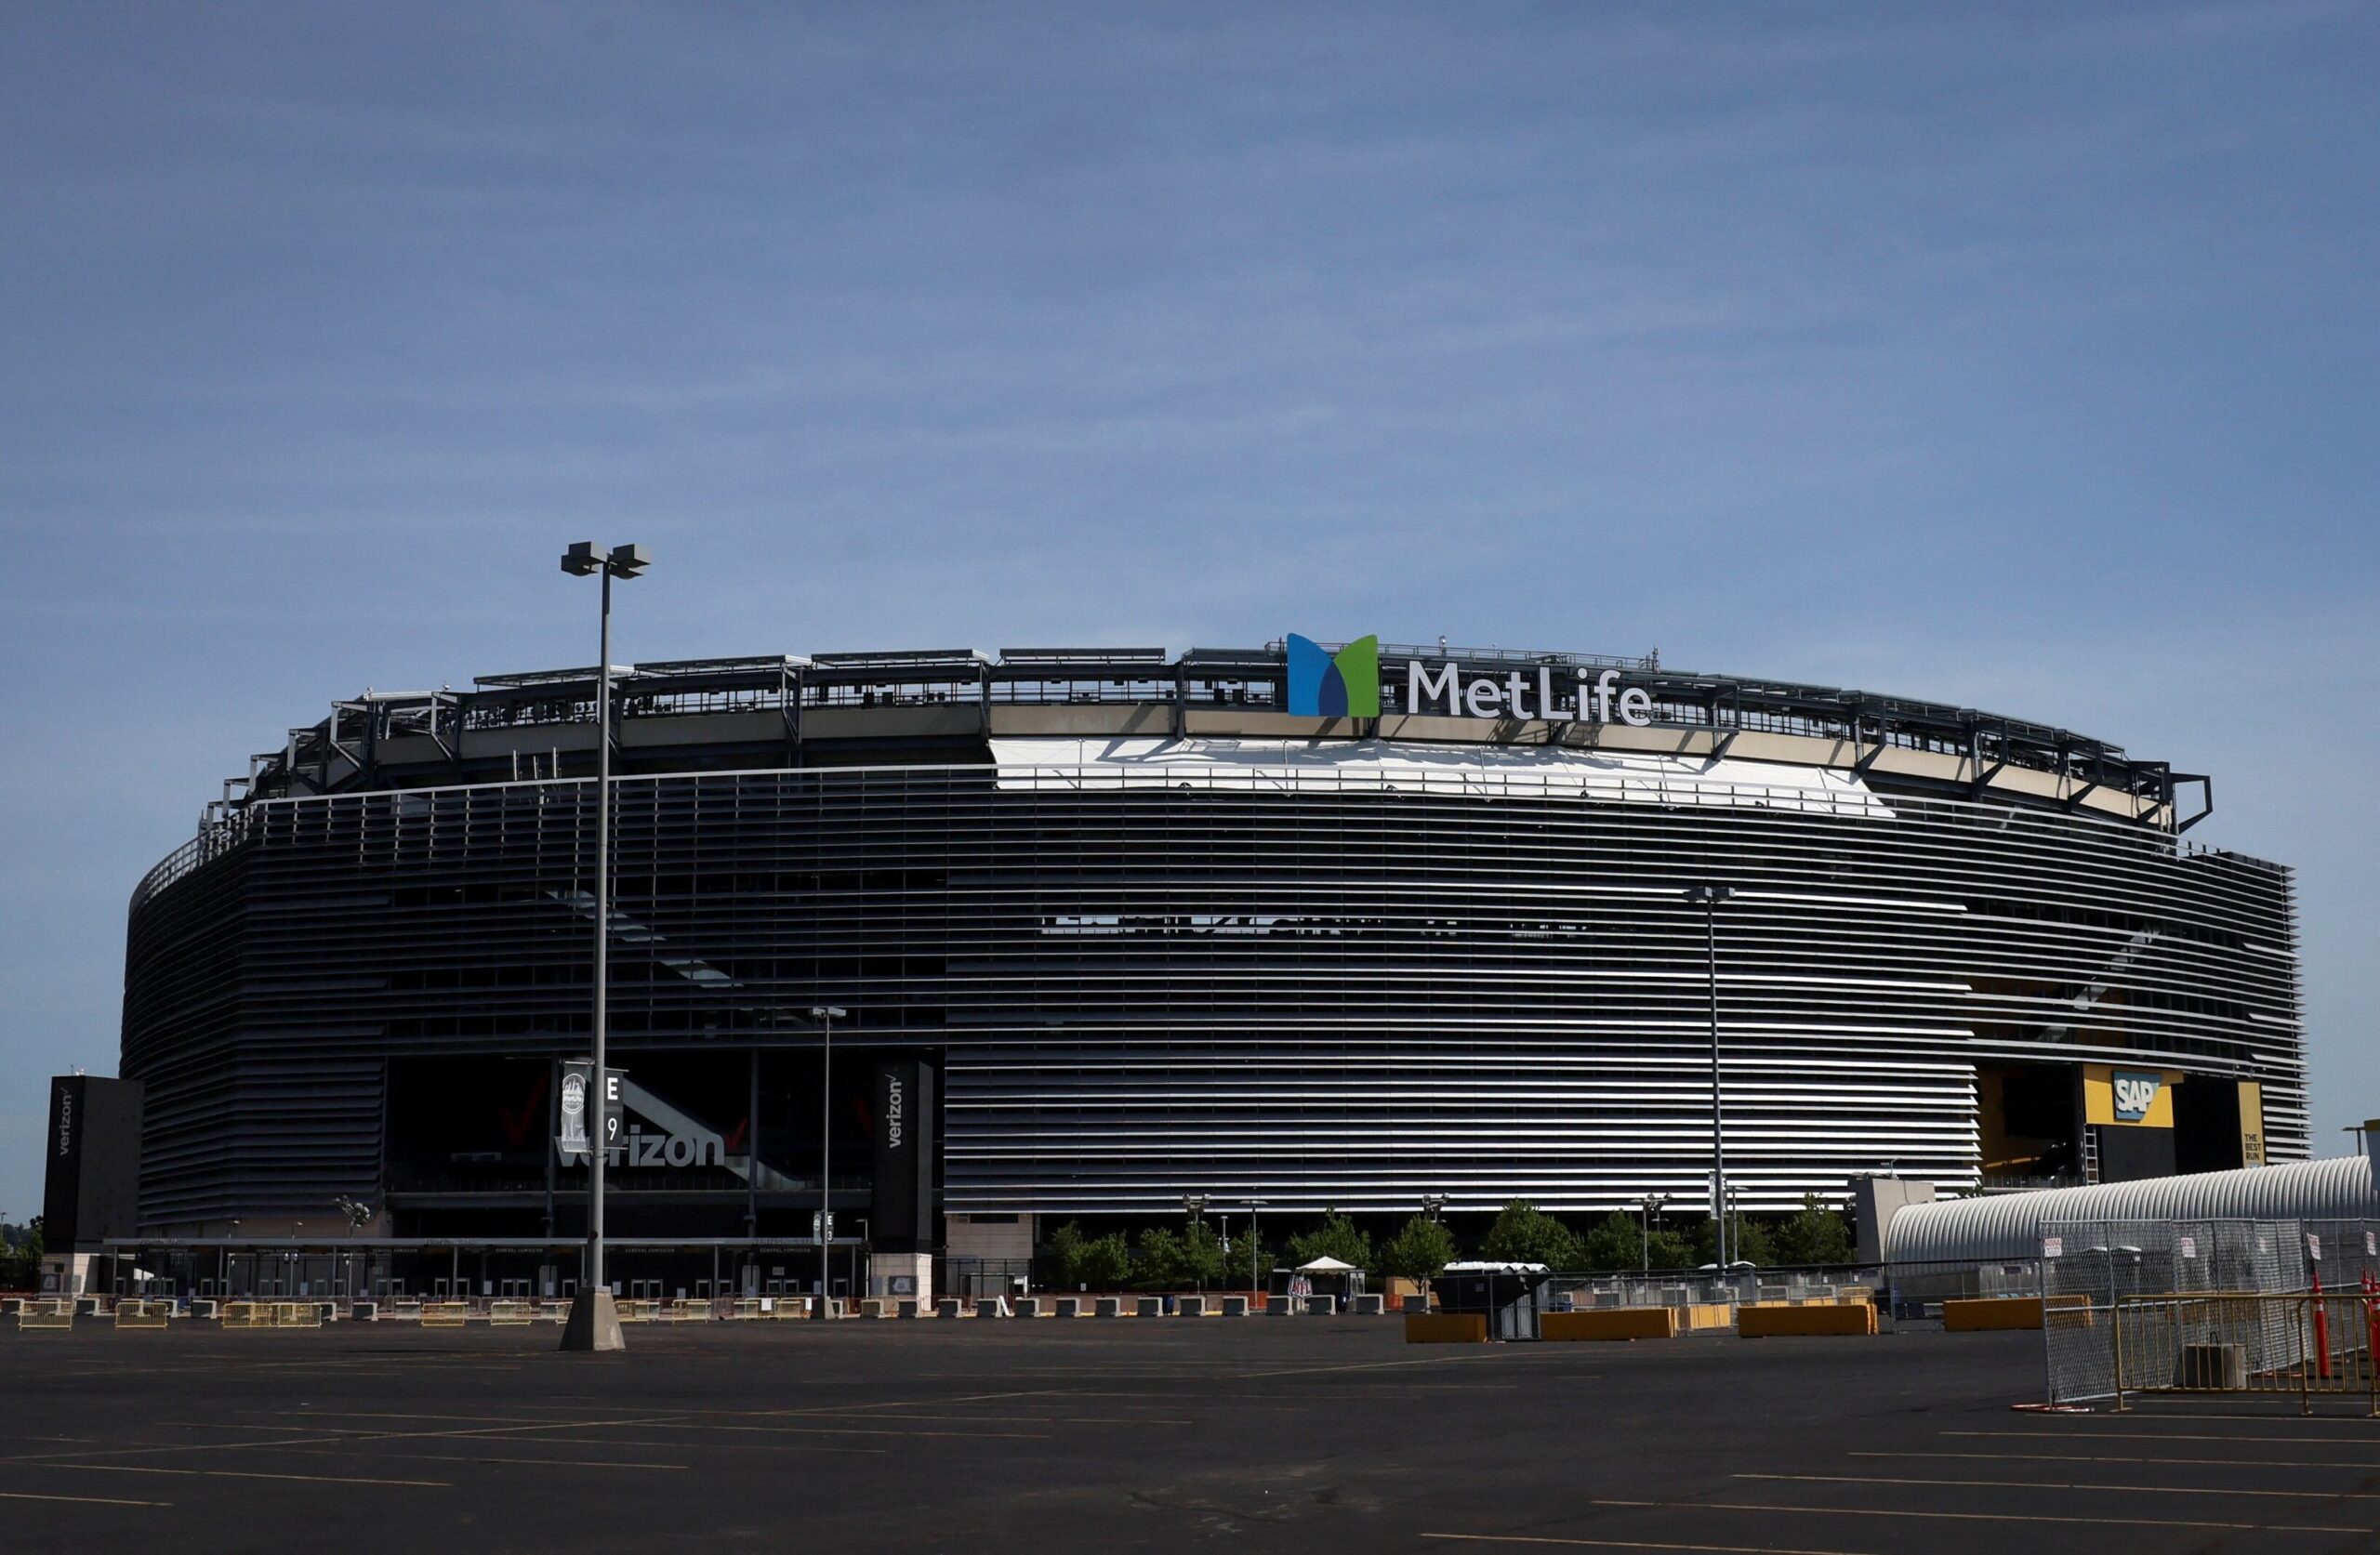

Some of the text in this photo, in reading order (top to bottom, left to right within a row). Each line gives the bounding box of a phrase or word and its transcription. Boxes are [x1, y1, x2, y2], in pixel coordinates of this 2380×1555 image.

[1408, 661, 1651, 727] MetLife
[607, 1077, 618, 1100] E
[2116, 1079, 2154, 1113] SAP
[60, 1094, 73, 1155] verizon
[886, 1081, 902, 1149] verizon
[607, 1117, 617, 1141] 9
[2244, 1133, 2257, 1141] THE
[554, 1125, 724, 1167] vrizon
[2245, 1142, 2261, 1151] BEST
[2246, 1152, 2259, 1160] RUN
[827, 1215, 833, 1226] E
[827, 1231, 833, 1241] 3
